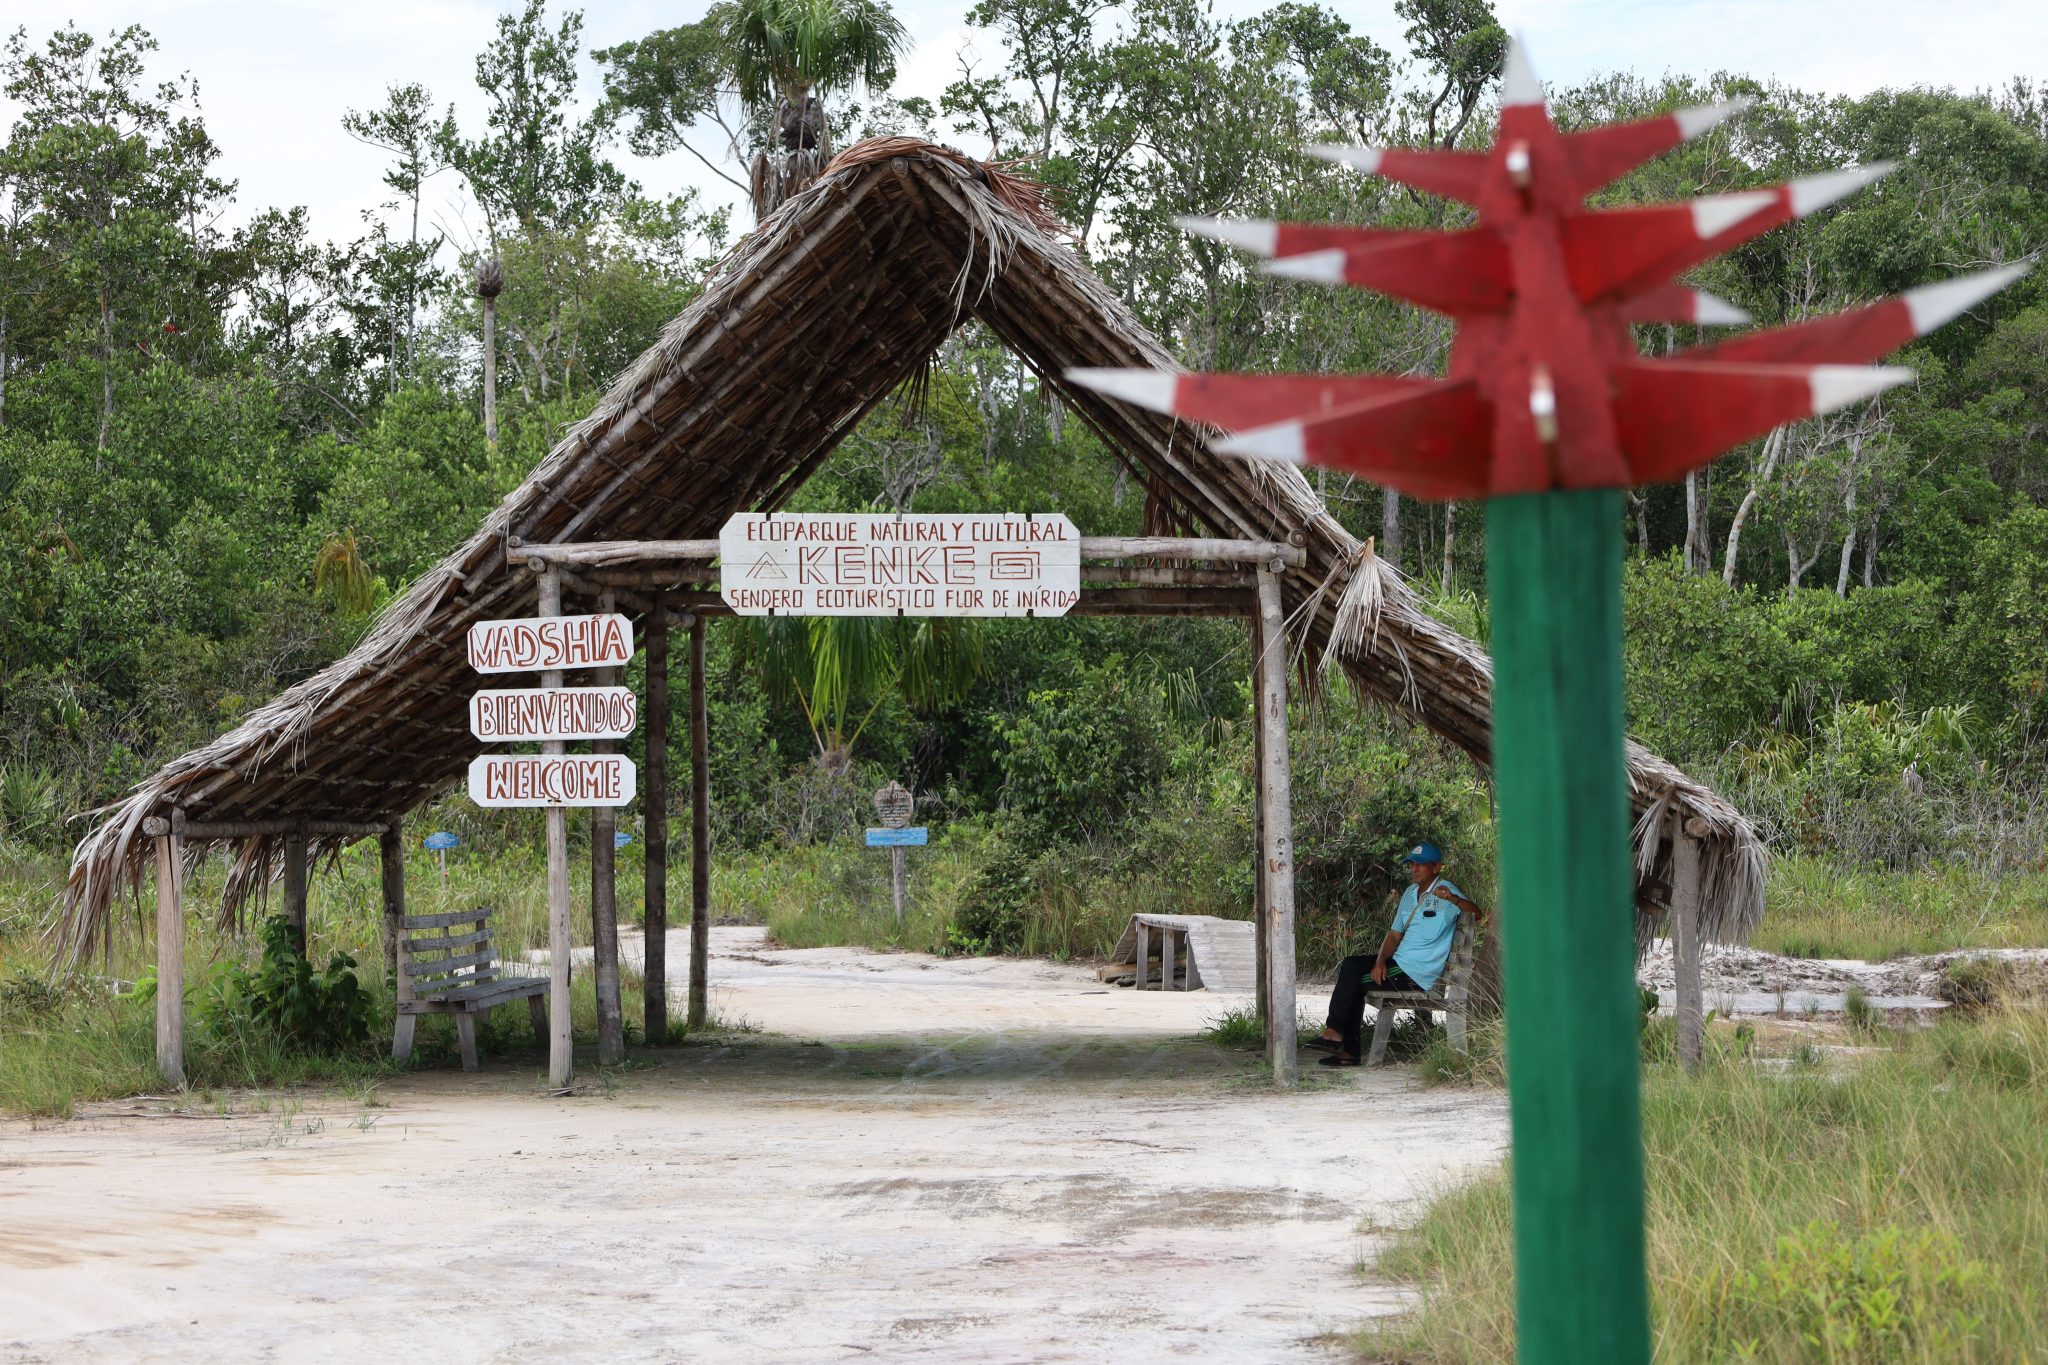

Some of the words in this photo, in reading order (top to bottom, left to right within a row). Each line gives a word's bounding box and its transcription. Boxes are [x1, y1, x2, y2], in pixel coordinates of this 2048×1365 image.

[747, 521, 857, 541] ECOPARQUE
[871, 521, 947, 541] NATURAL
[952, 522, 965, 541] Y
[972, 521, 1067, 541] CULTURAL
[799, 546, 975, 585] KENKE
[730, 589, 803, 608] SENDERO
[816, 582, 934, 608] ECOTURÍSTICO
[946, 589, 984, 608] FLOR
[993, 590, 1009, 608] DE
[1017, 585, 1079, 608] INÍRIDA
[470, 614, 628, 667] MADSHÍA
[477, 692, 637, 735] BIENVENIDOS
[486, 760, 620, 801] WELCOME
